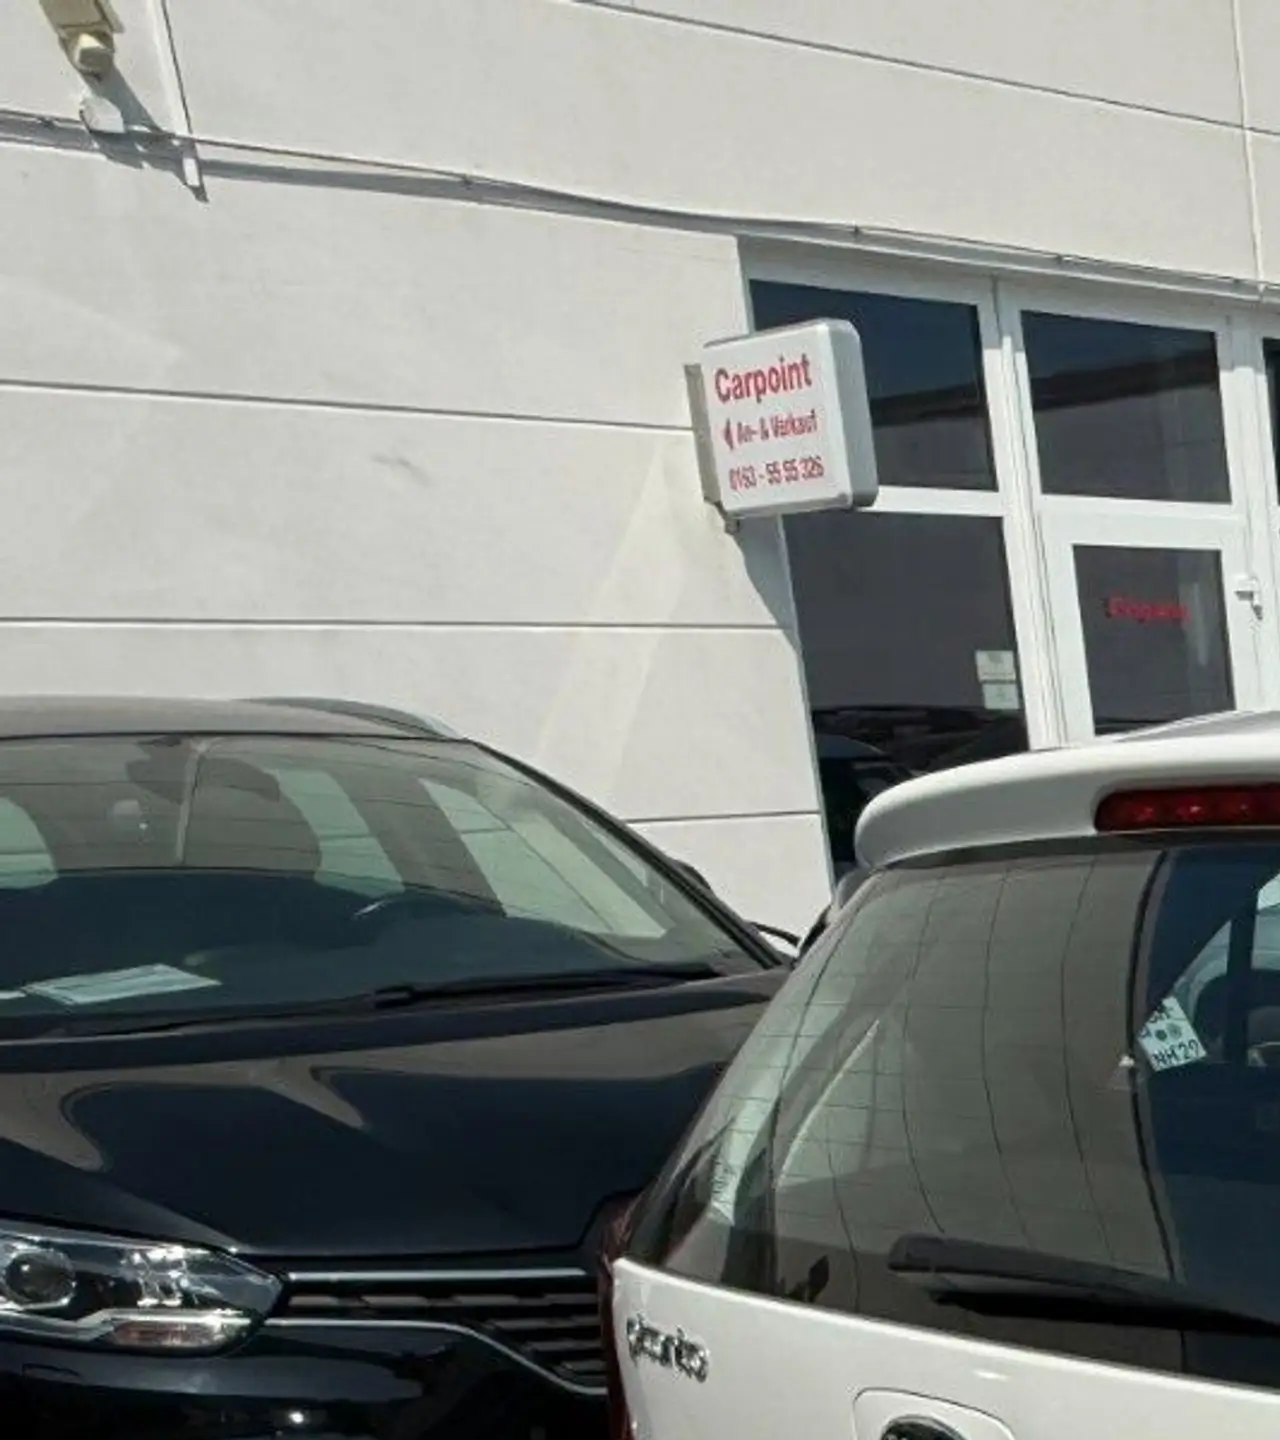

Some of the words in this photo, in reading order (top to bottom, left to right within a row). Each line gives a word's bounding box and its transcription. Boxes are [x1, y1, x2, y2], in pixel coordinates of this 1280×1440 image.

[715, 353, 812, 403] Carpoint
[770, 409, 818, 438] Verkauf
[729, 465, 756, 490] 0163
[766, 461, 783, 485] 55
[784, 459, 799, 483] 55
[801, 455, 824, 480] 326
